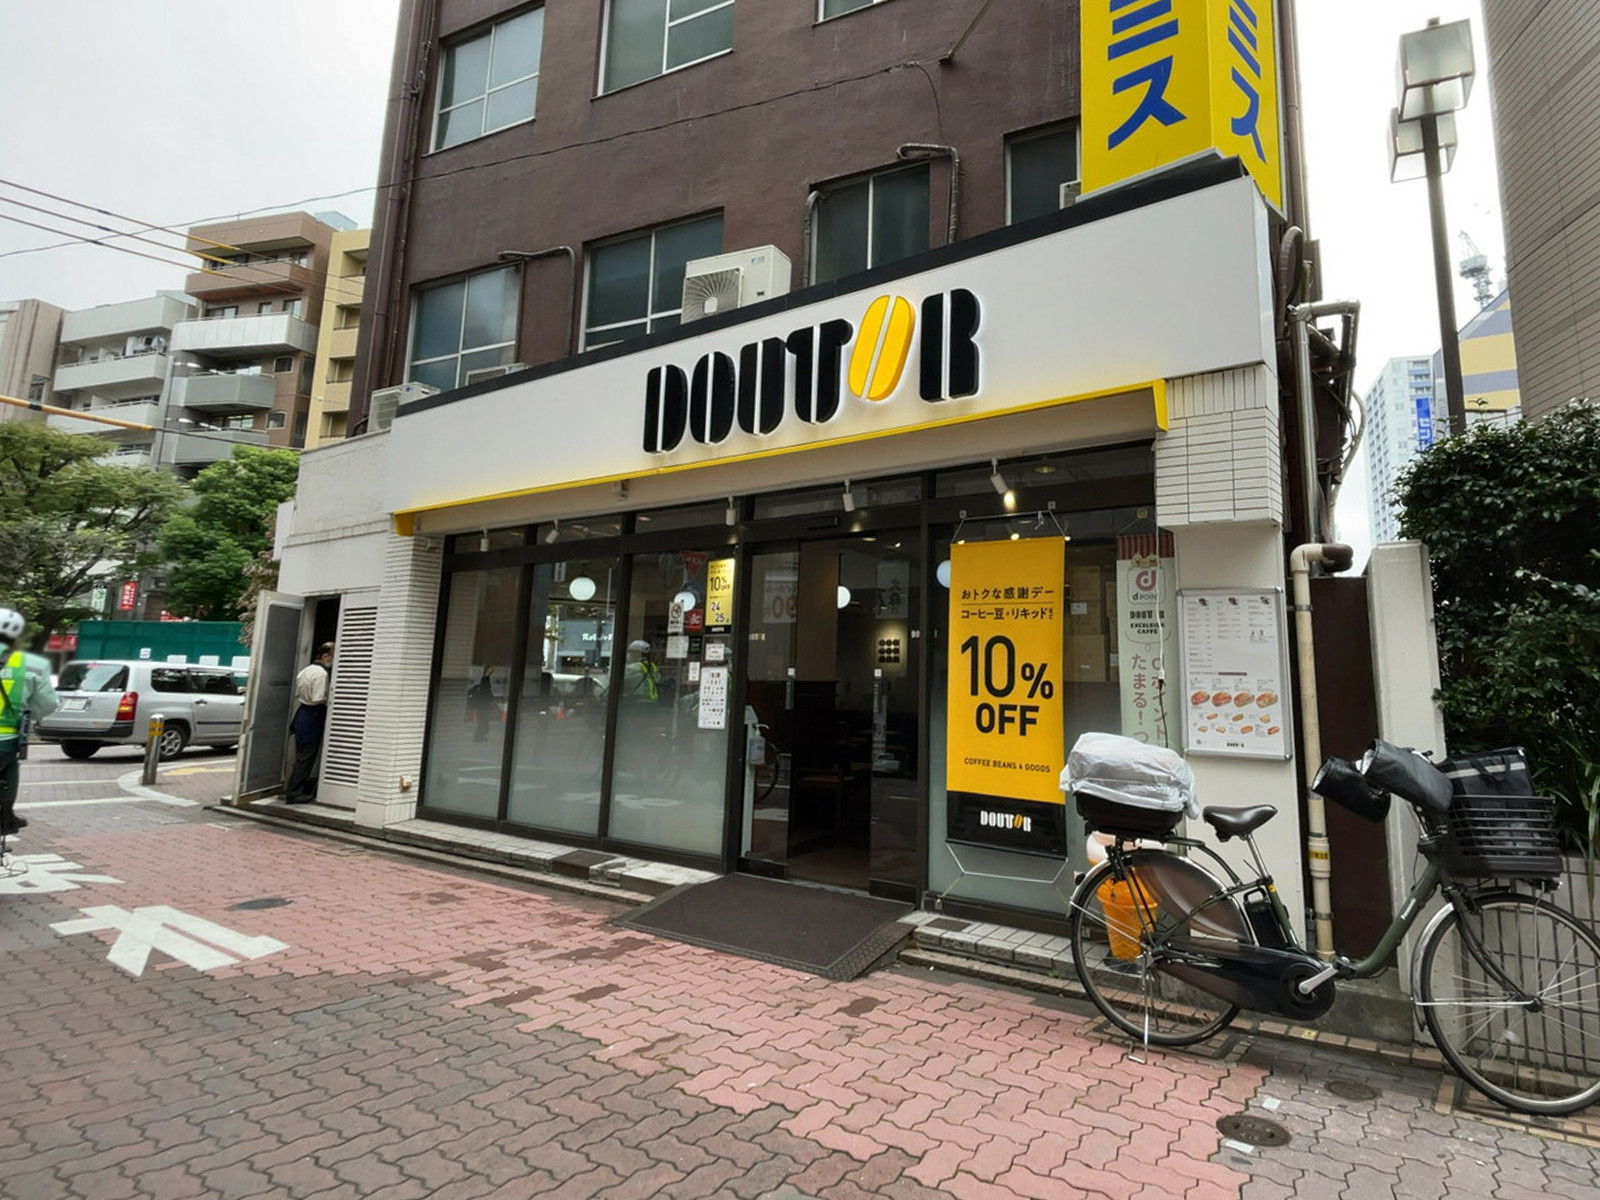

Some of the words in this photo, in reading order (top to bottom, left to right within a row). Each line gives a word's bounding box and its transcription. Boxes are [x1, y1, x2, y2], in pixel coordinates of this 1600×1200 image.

[643, 288, 982, 454] DOUTOR
[961, 586, 1054, 601] おトクな感謝デー
[961, 634, 1054, 699] 10%
[975, 702, 1040, 737] OFF
[964, 758, 991, 768] COFFEE
[992, 760, 1017, 770] BEANS
[1024, 763, 1051, 773] GOODS
[980, 810, 1032, 832] DOUTOR
